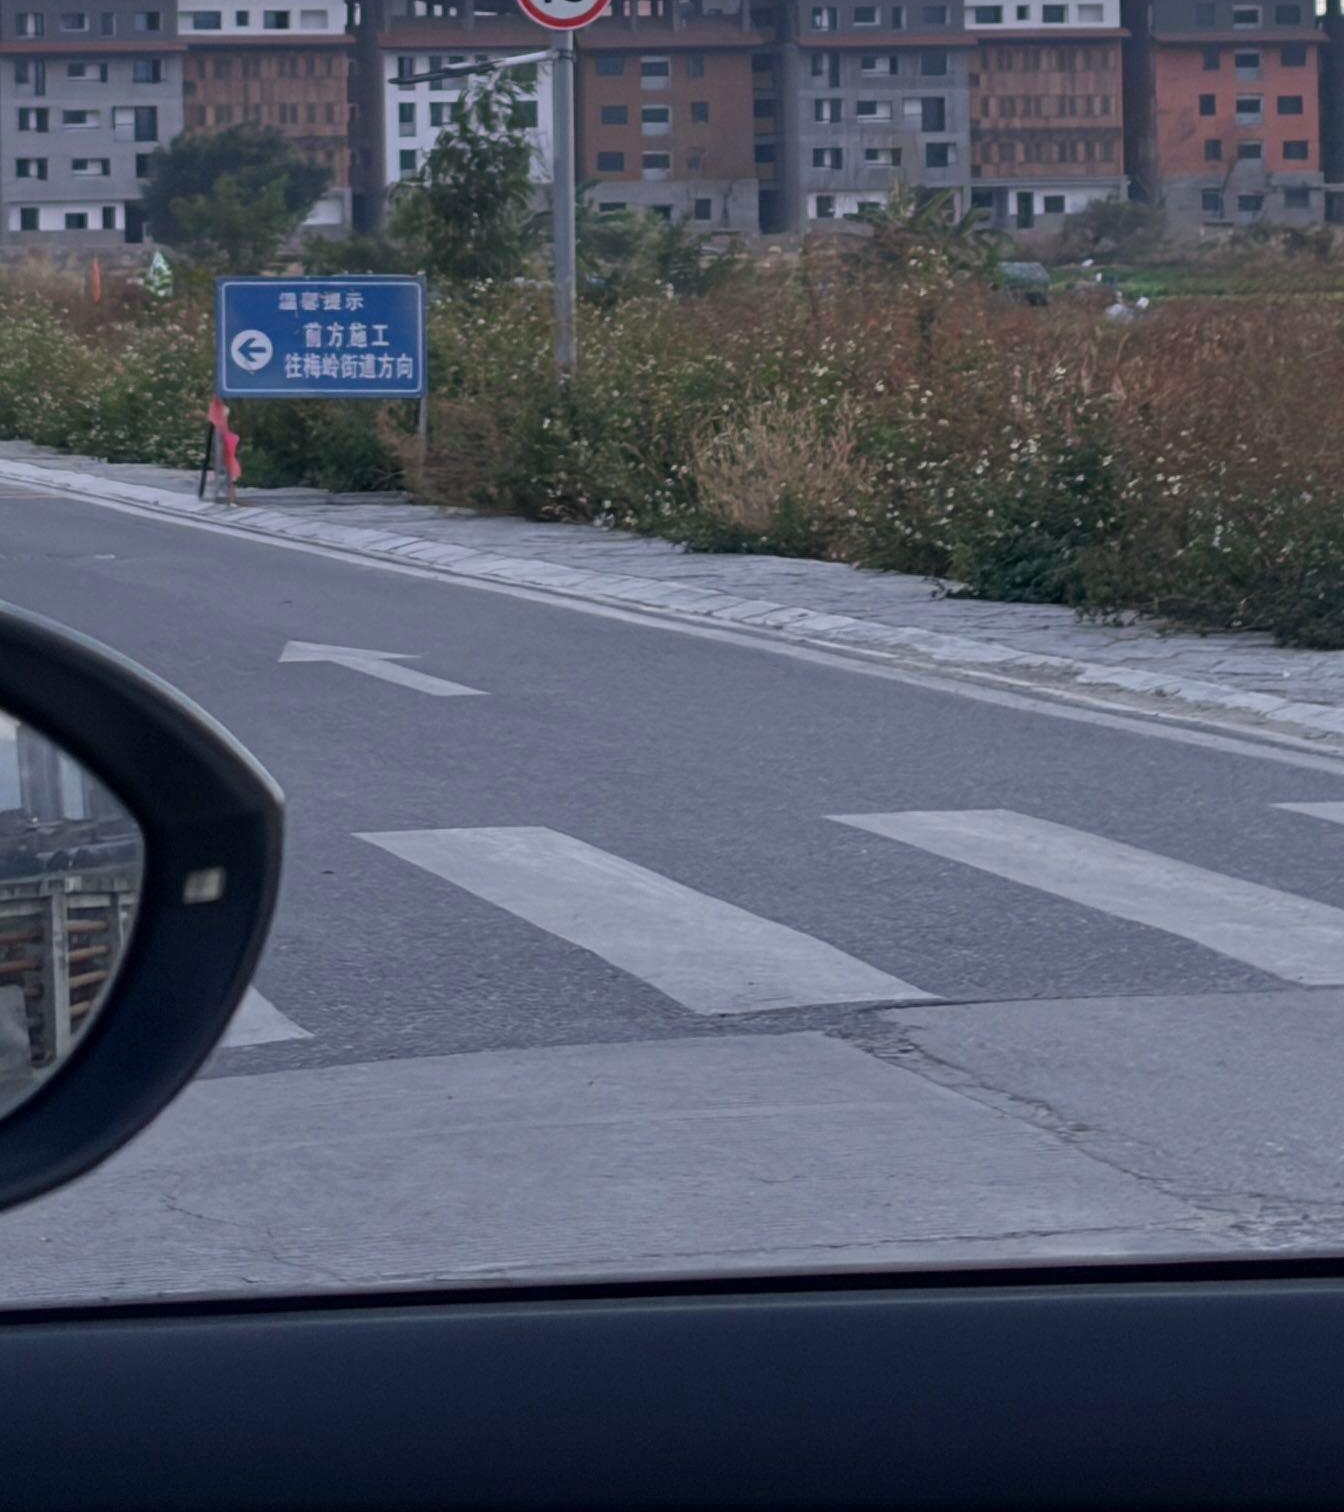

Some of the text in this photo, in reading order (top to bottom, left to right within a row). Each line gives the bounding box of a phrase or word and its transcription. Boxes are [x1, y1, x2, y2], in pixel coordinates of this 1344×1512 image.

[278, 291, 365, 311] 温馨提示
[304, 321, 390, 348] 前方施工
[284, 352, 414, 379] 往梅岭街道方向
